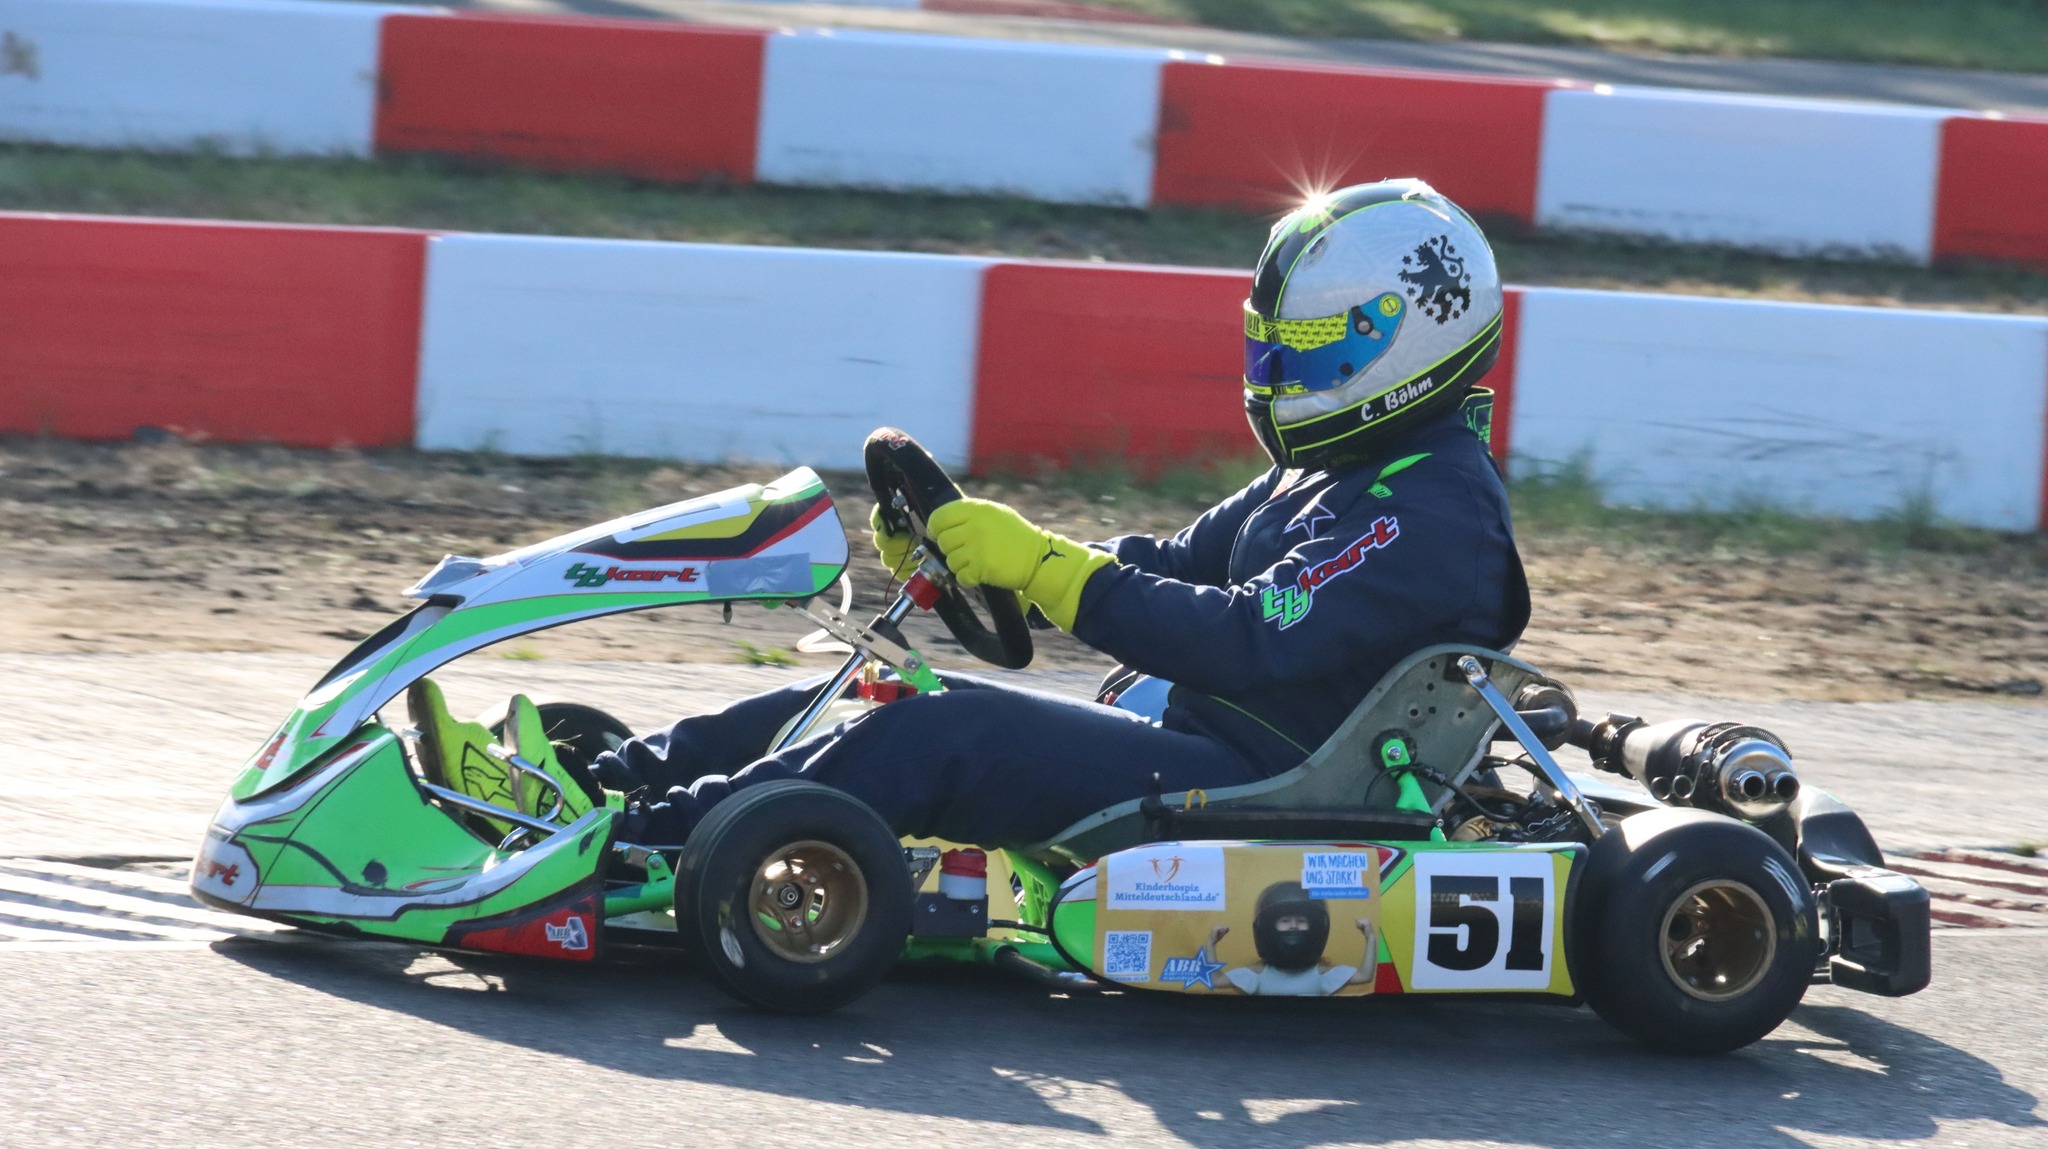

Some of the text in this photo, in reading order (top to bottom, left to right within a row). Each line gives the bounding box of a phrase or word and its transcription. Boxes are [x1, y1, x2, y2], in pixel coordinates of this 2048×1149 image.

[1361, 377, 1433, 421] C. Böhm
[1308, 854, 1366, 868] WIR MACHEN
[1305, 870, 1357, 885] UNS STARK!
[1135, 882, 1199, 894] Kinderhospiz
[1427, 875, 1544, 971] 51
[1164, 959, 1202, 972] ABR
